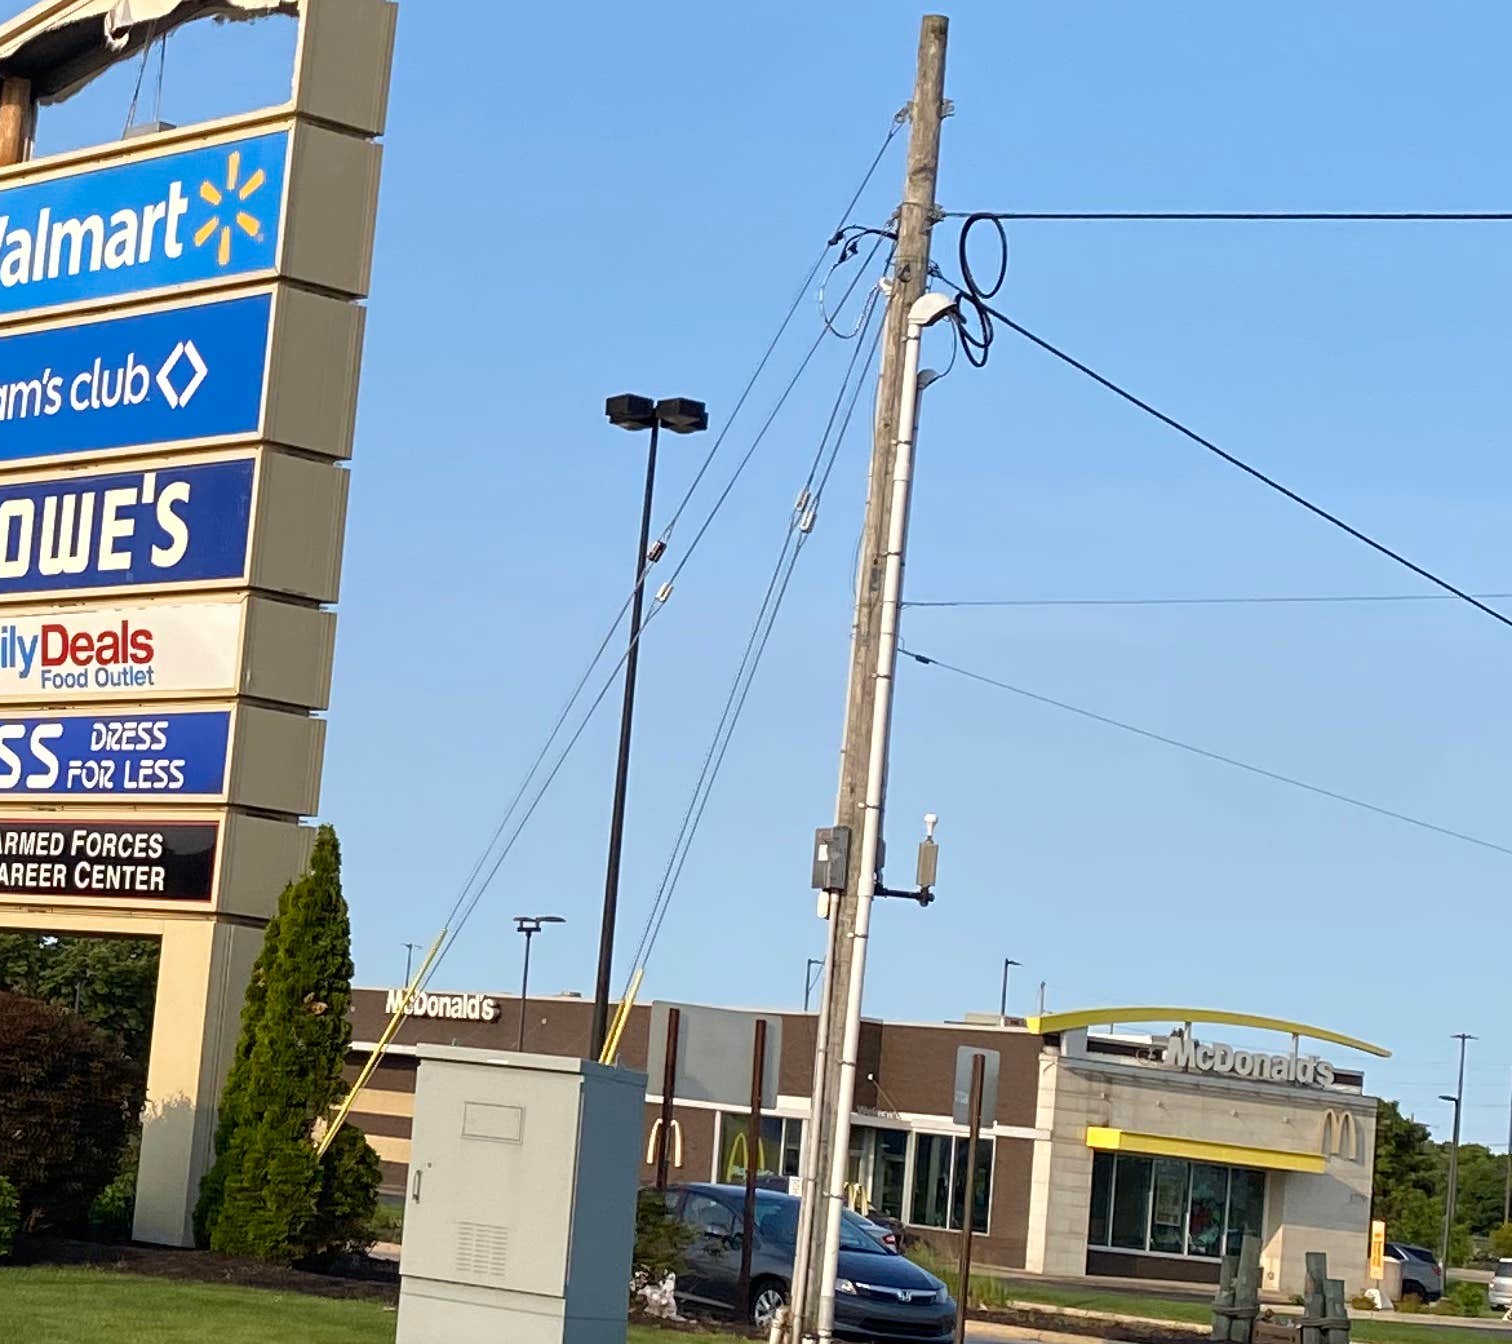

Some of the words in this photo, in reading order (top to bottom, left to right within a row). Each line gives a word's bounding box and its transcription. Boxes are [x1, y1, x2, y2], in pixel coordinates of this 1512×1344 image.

[70, 352, 150, 411] club
[41, 669, 89, 689] Food
[94, 665, 155, 687] Outlet
[91, 721, 169, 752] DRESS
[67, 760, 116, 789] FOR
[123, 759, 186, 789] LESS
[71, 830, 164, 859] FORCES
[74, 861, 166, 891] CENTER
[1164, 1035, 1336, 1087] McDonald's
